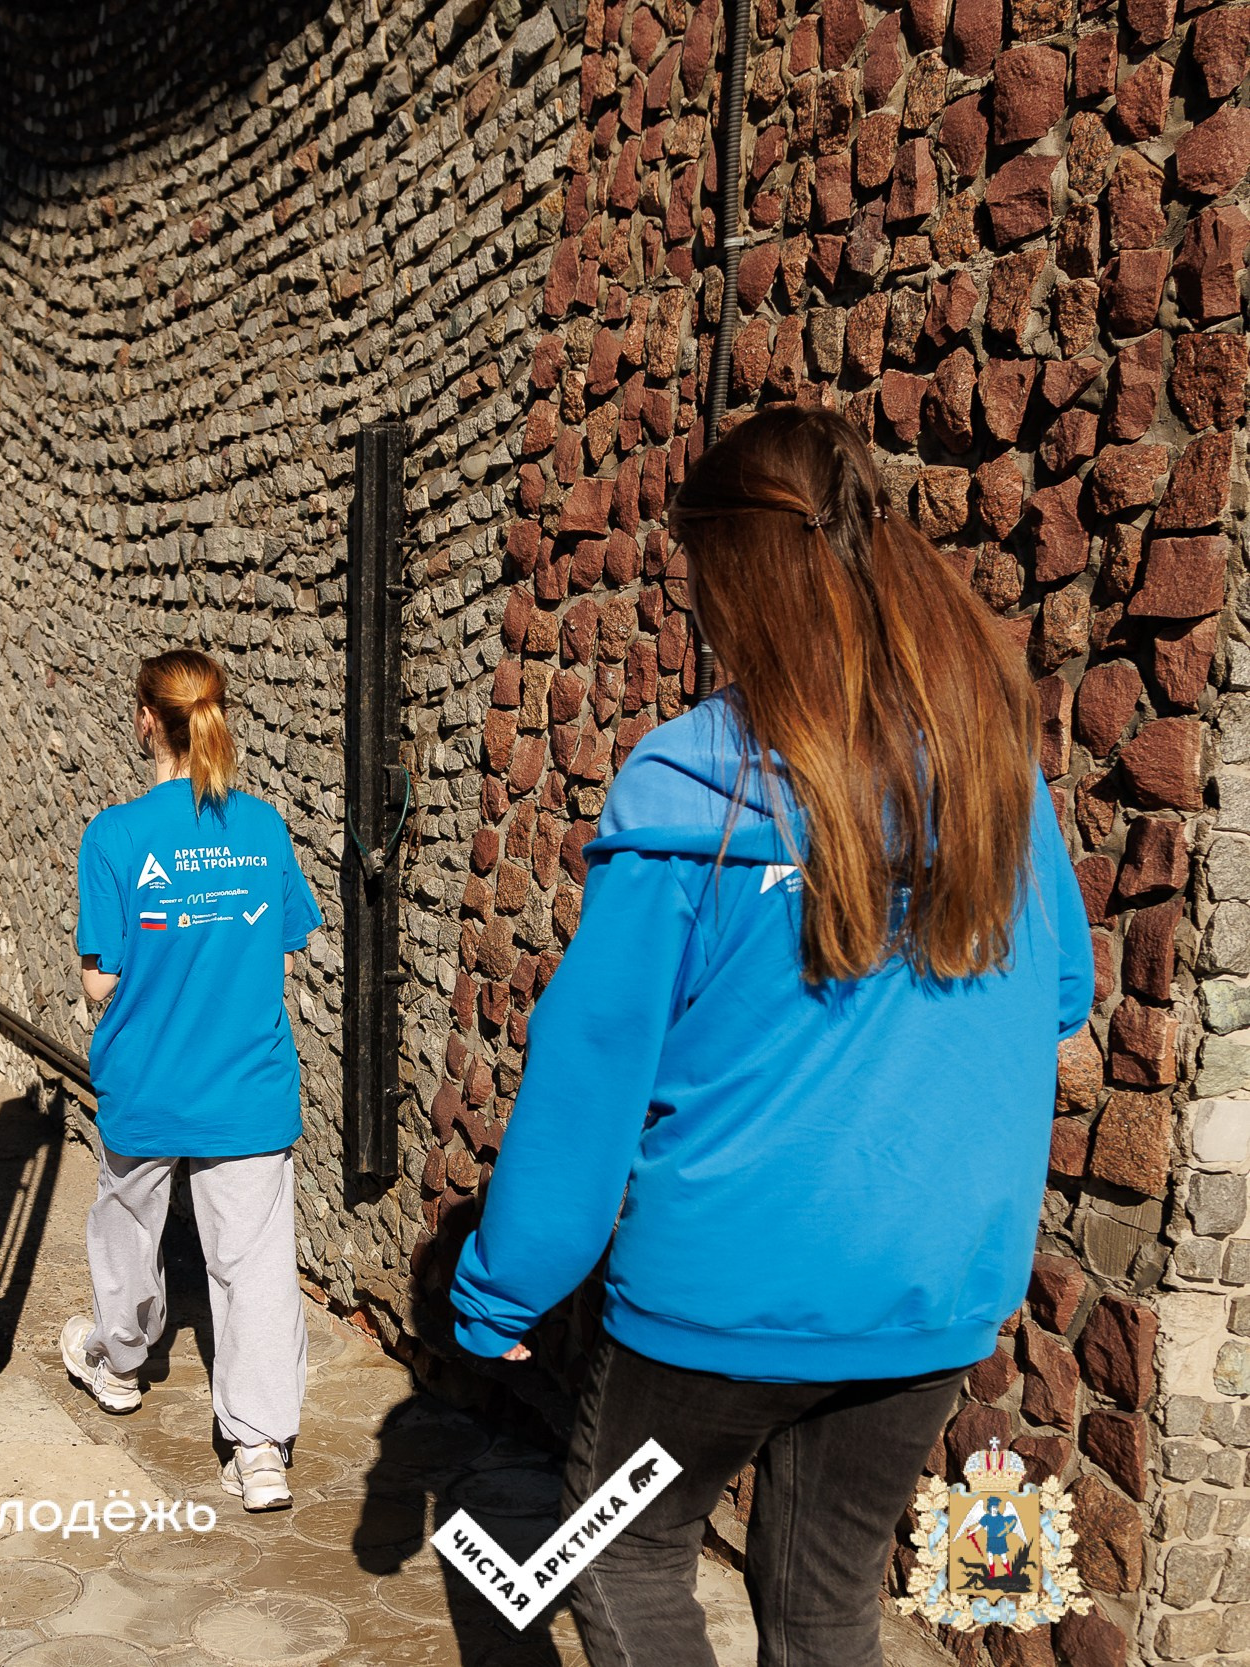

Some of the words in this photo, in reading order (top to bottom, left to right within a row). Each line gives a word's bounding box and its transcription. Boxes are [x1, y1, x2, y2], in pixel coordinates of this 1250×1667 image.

[174, 846, 231, 860] АРКТИКА
[175, 859, 200, 872] ЛЁД
[202, 856, 268, 870] ТРОНУЛСЯ
